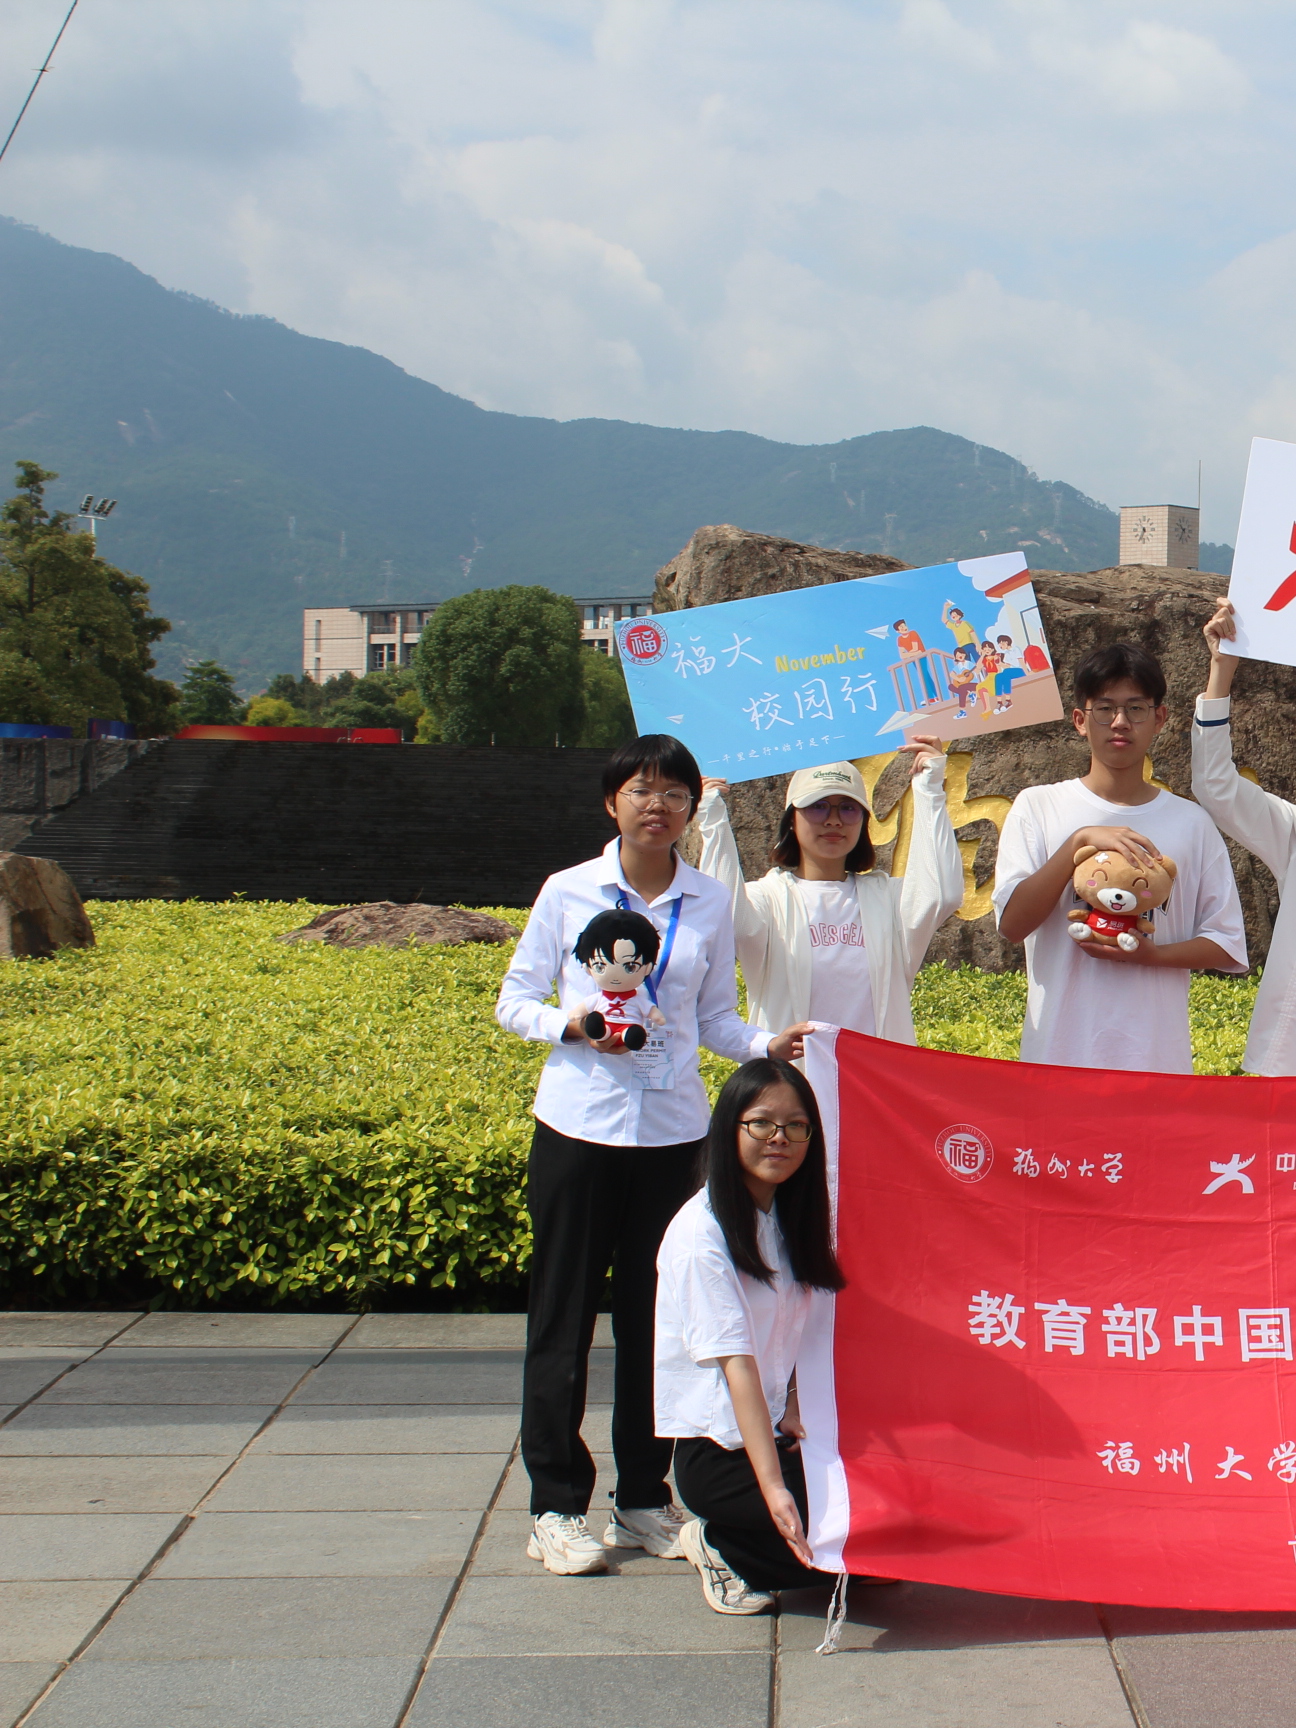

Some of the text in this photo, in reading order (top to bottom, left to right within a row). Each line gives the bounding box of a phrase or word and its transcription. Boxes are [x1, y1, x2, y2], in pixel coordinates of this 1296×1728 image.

[671, 633, 763, 679] 福大
[775, 644, 866, 673] November
[742, 672, 877, 730] 校园行
[1012, 1147, 1123, 1184] 福州大学
